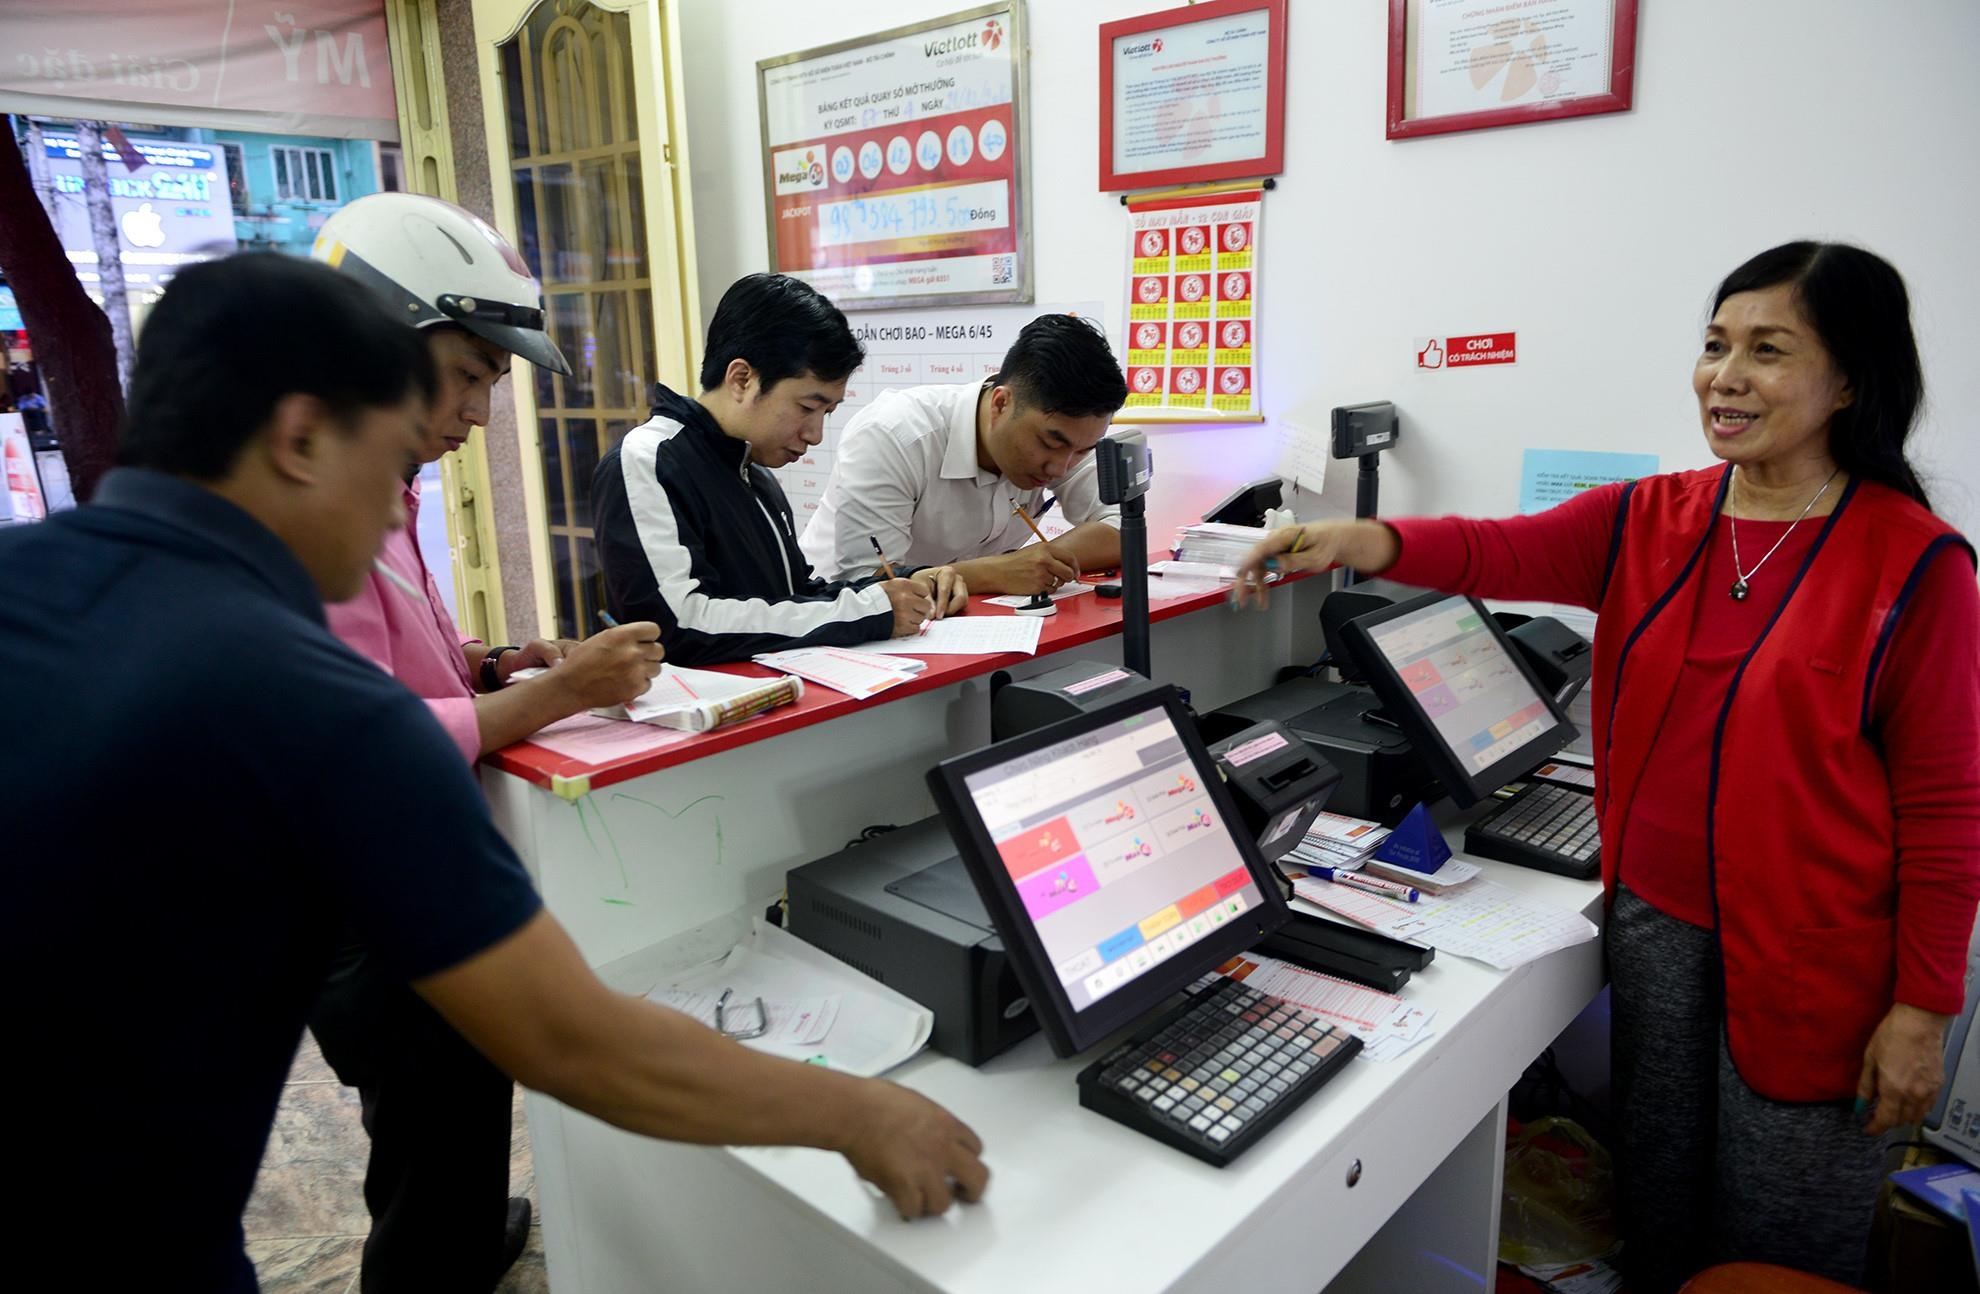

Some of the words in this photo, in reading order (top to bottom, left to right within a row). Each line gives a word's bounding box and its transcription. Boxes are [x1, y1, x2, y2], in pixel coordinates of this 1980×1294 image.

[924, 31, 978, 58] Vietlott
[818, 101, 839, 114] BẢNG
[839, 96, 853, 110] KẾT
[854, 93, 870, 108] QUẢ
[871, 90, 891, 104] QUAY
[893, 86, 904, 99] SỐ
[905, 82, 919, 96] MỞ
[919, 77, 956, 95] THƯỜNG
[921, 98, 943, 112] NGÀY
[782, 206, 812, 219] JACKPOT
[857, 323, 877, 340] DẪN
[879, 326, 903, 341] CHƠI
[905, 326, 926, 340] BAO
[936, 325, 967, 340] MEGA
[968, 324, 993, 339] 6/45
[1466, 338, 1493, 350] CHƠI
[1448, 353, 1460, 363] CÓ
[1460, 351, 1486, 362] TRÁCH
[1487, 350, 1514, 361] NHIỆM
[984, 364, 1000, 375] Trún
